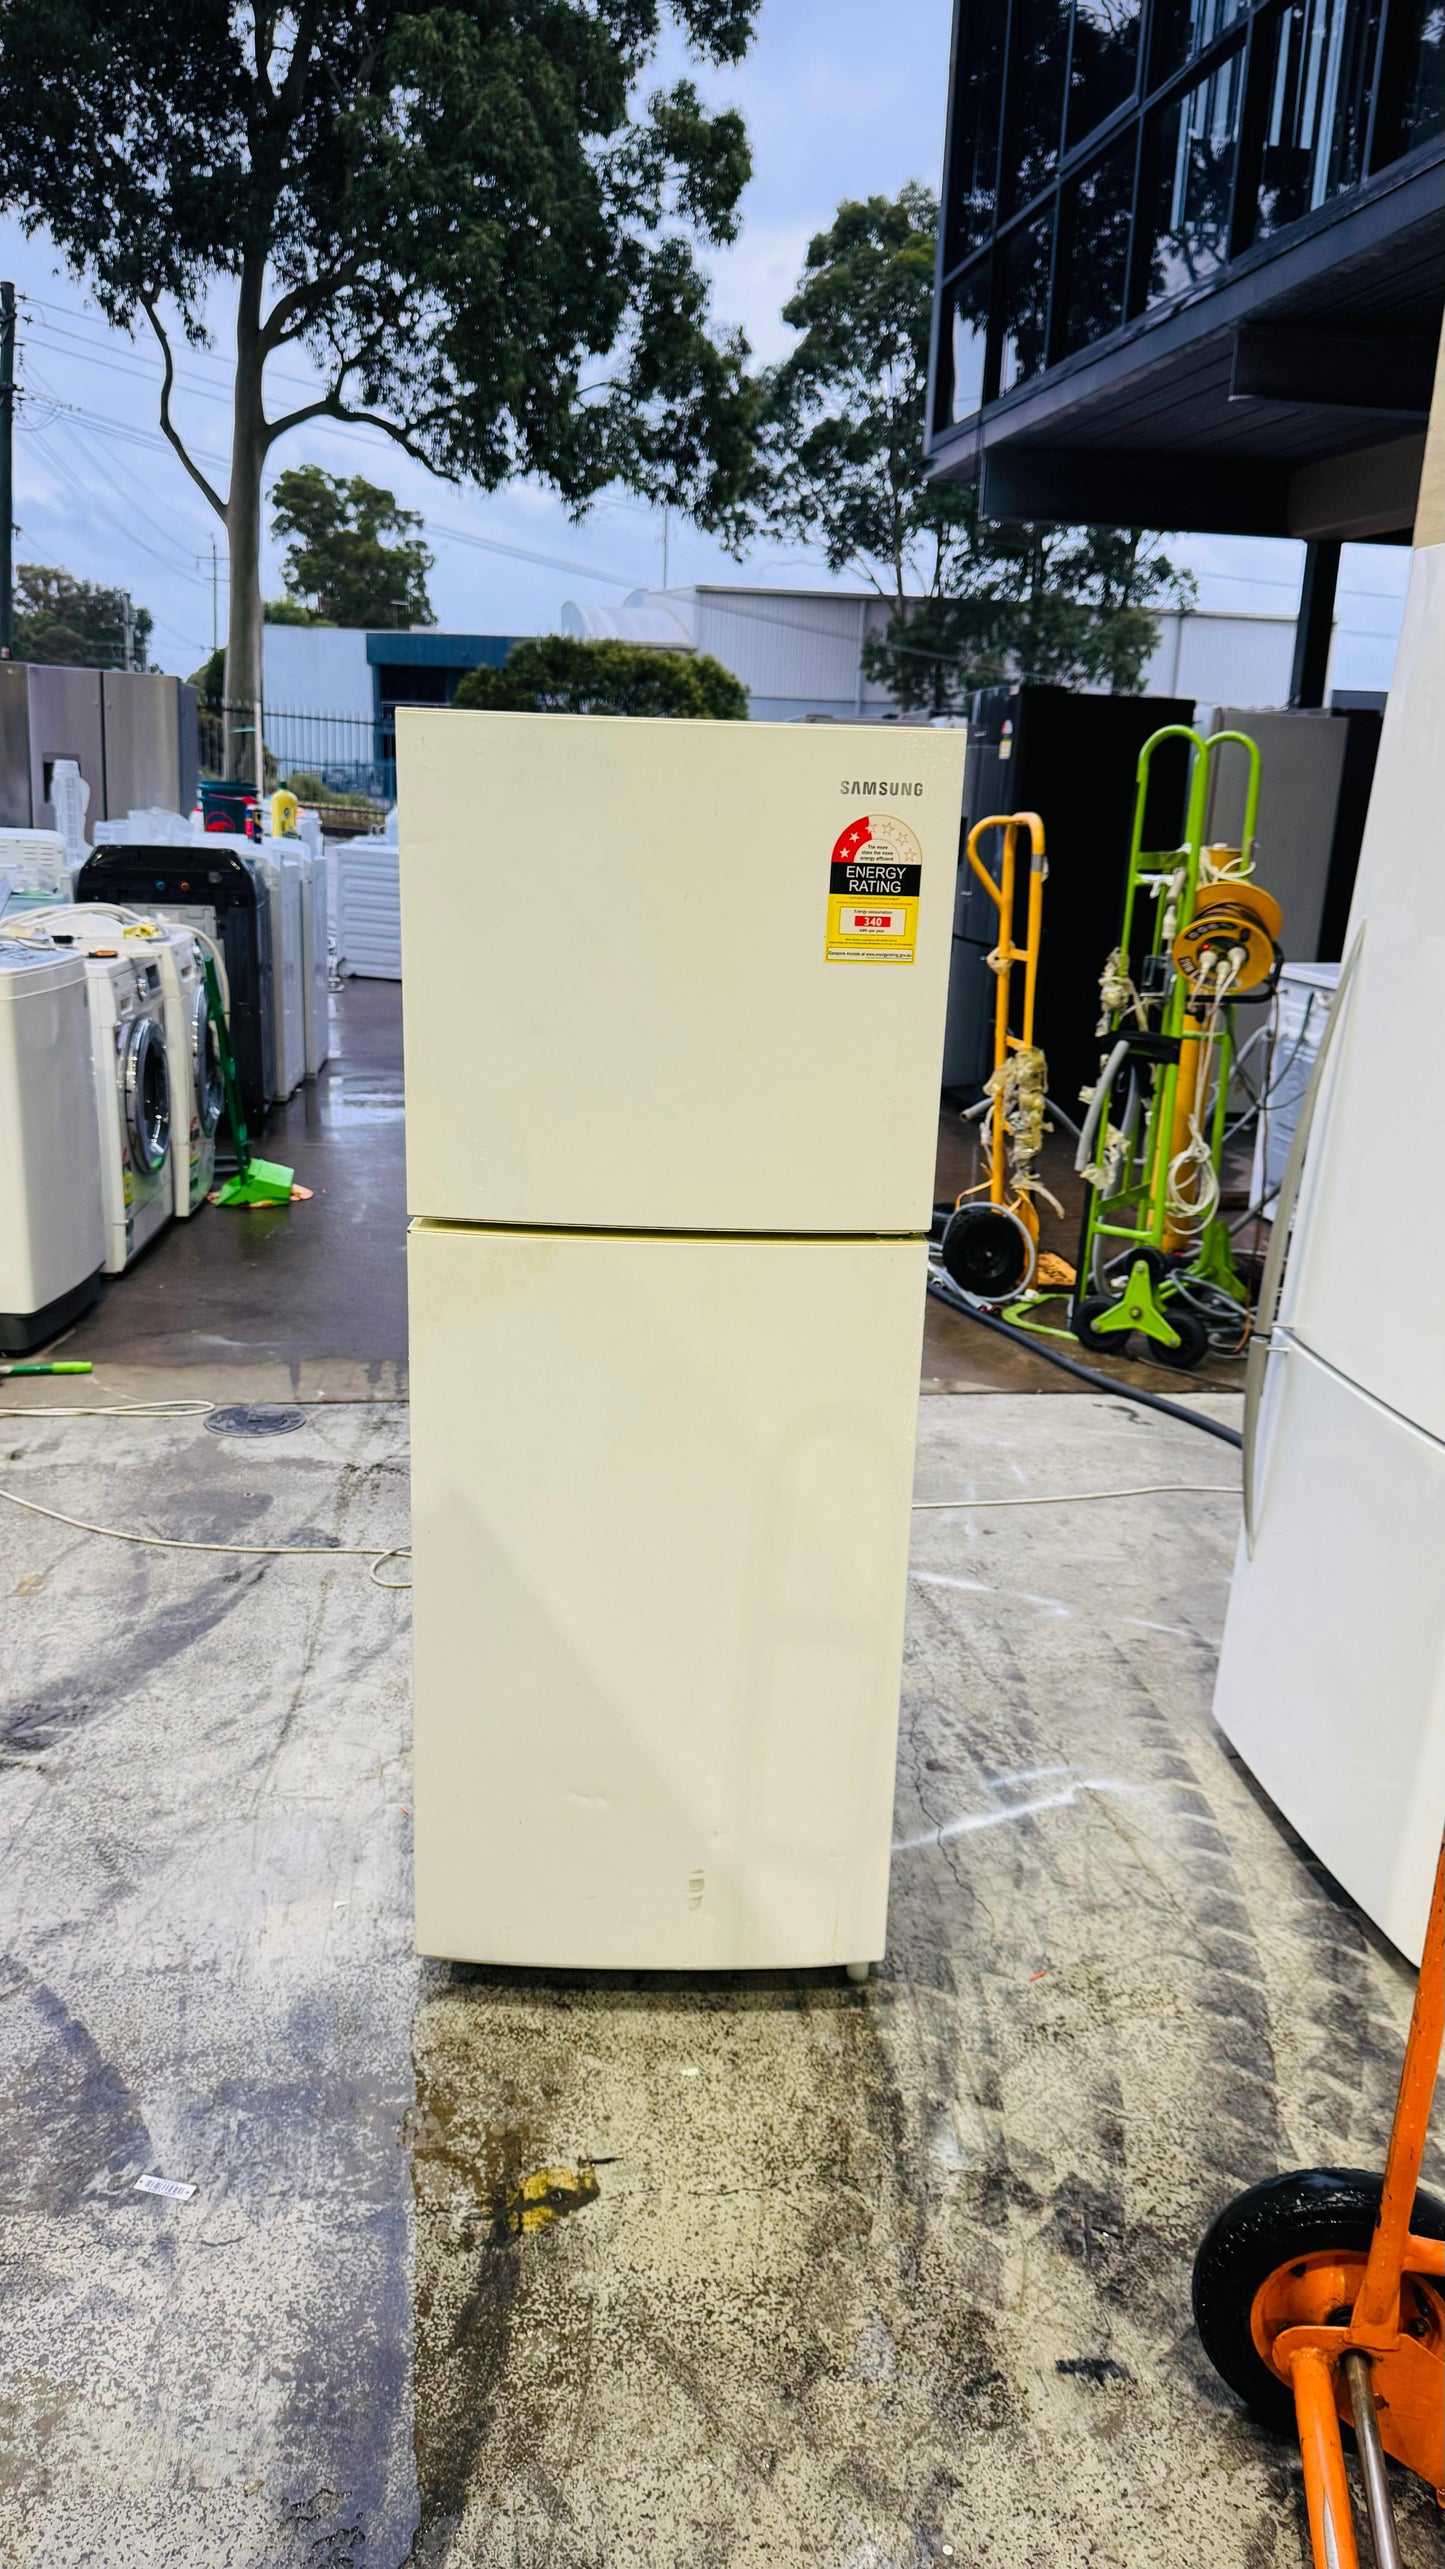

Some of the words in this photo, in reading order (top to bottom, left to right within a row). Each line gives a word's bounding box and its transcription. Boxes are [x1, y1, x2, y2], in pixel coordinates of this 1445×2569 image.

[840, 781, 923, 796] SAMSUNG
[846, 866, 906, 879] ENERGY
[849, 880, 902, 893] RATING
[864, 917, 882, 926] 340
